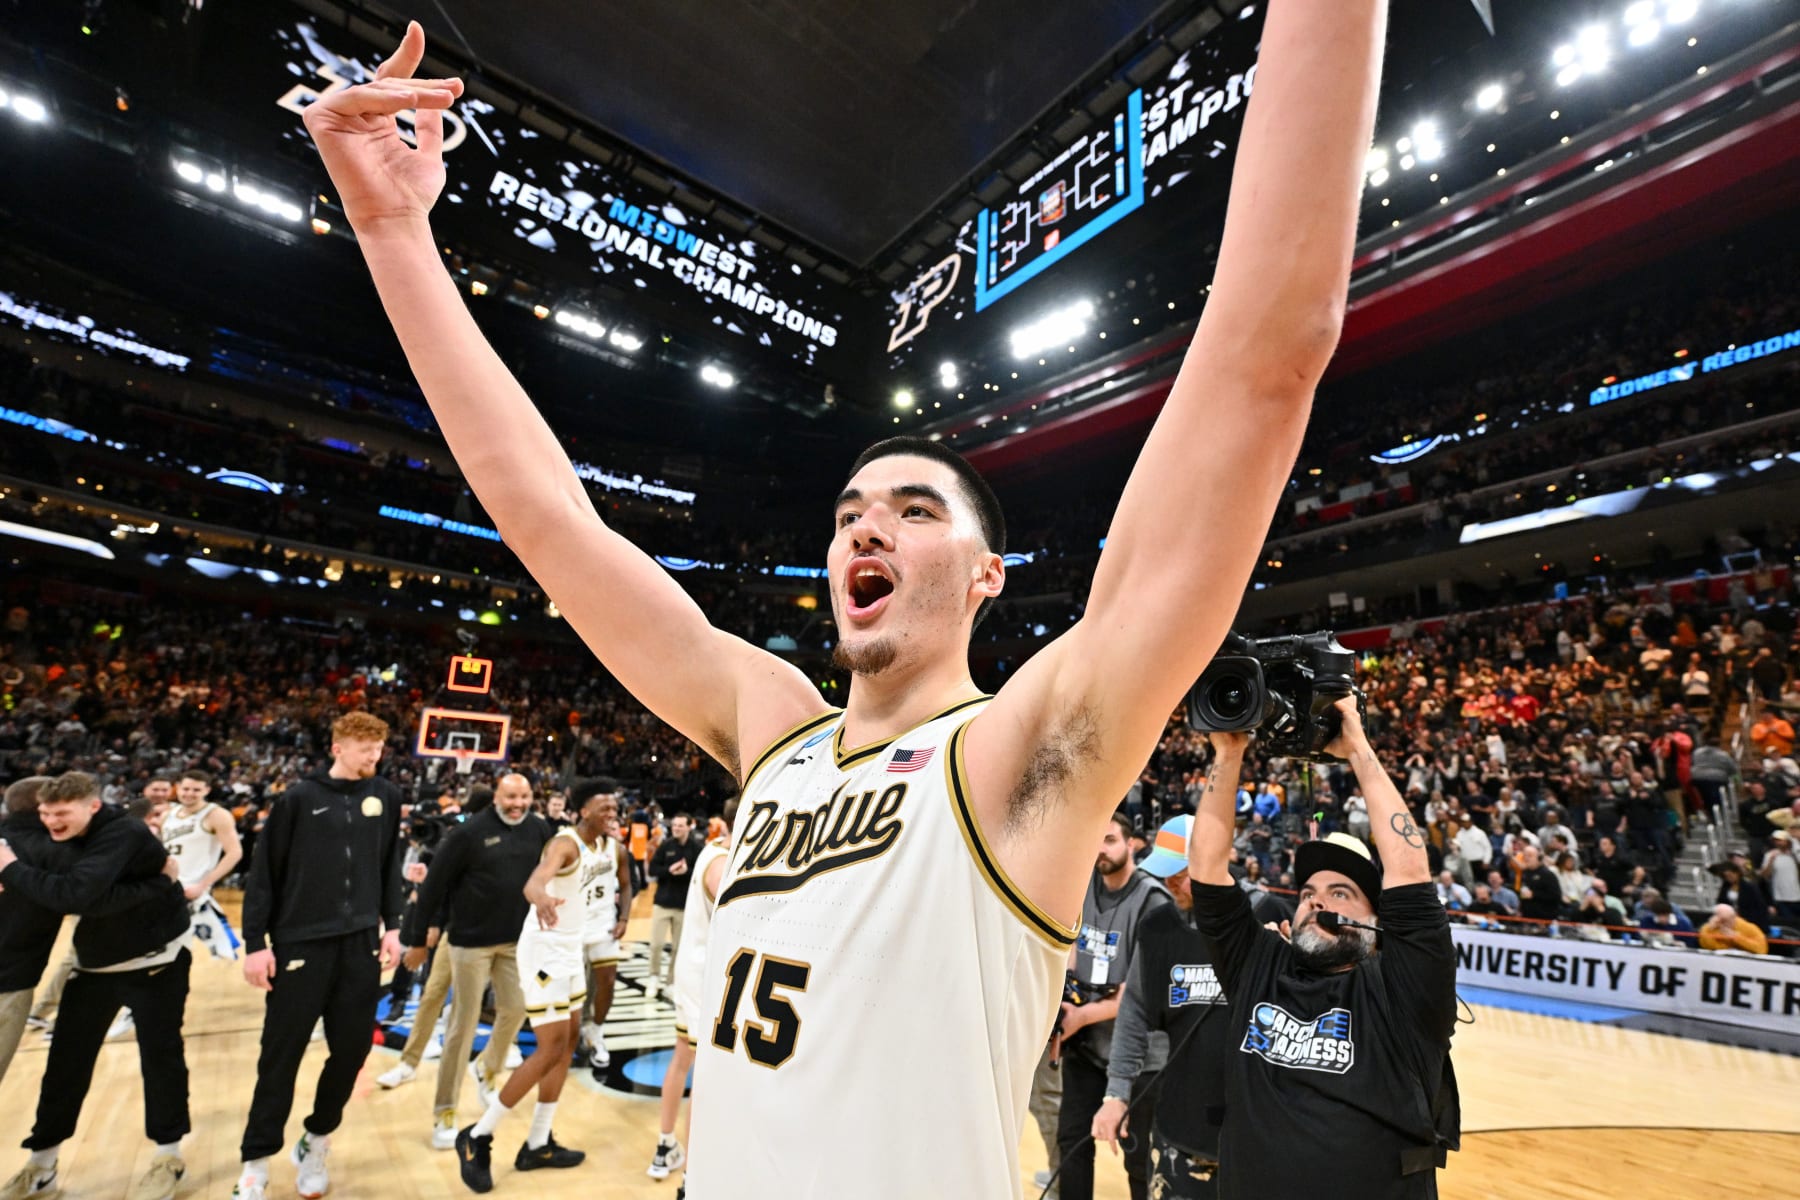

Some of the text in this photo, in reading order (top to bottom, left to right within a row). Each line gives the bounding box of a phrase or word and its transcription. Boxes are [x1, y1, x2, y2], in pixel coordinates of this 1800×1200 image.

[1142, 63, 1258, 168] AMPI
[489, 171, 838, 347] REGIONAL CHAMPIONS
[608, 198, 754, 281] MIDWEST
[723, 778, 908, 888] Purdue
[711, 946, 811, 1070] 15
[1271, 1009, 1319, 1043] ARCH
[1640, 964, 1687, 997] OF
[1700, 971, 1800, 1015] DETR
